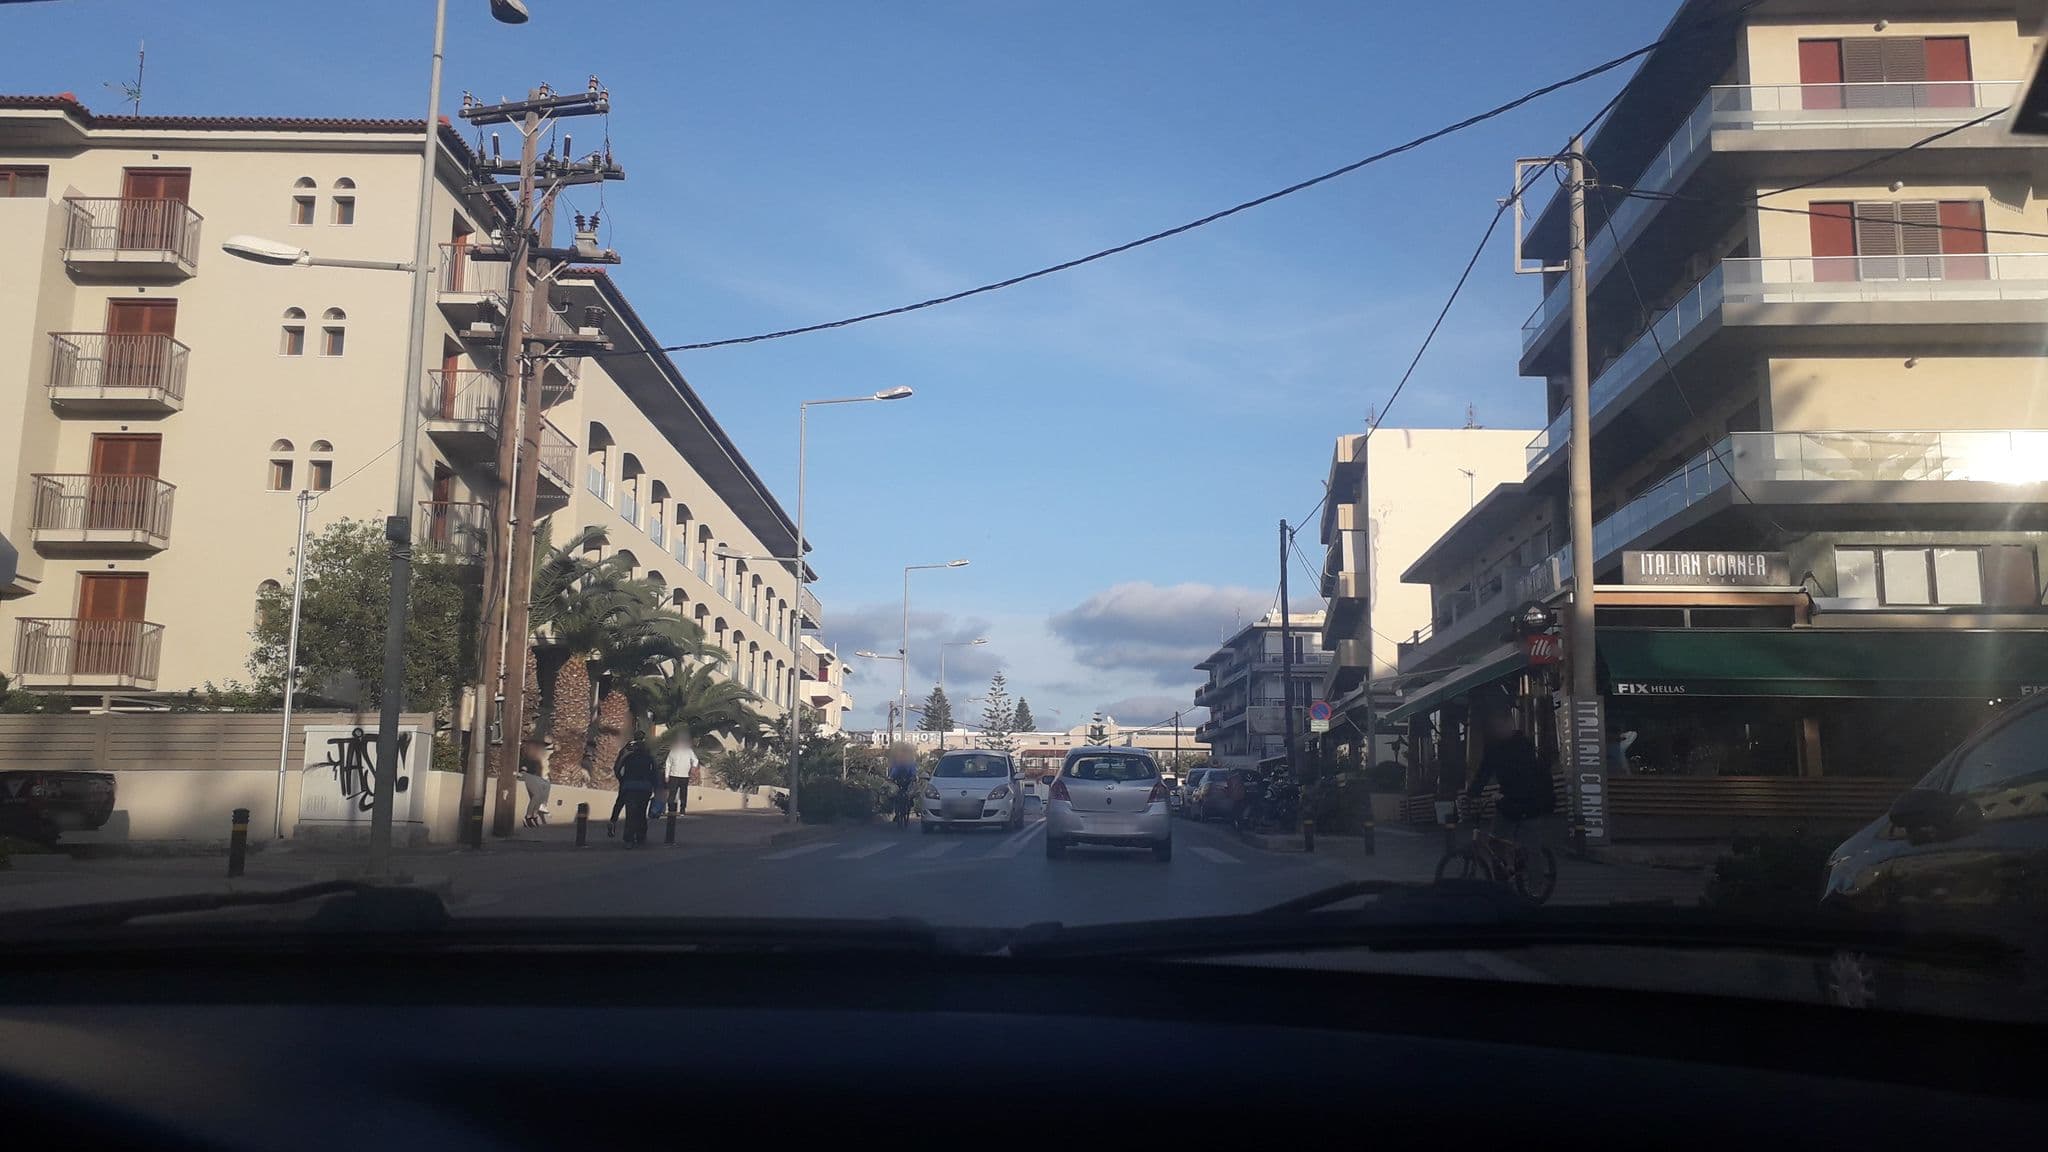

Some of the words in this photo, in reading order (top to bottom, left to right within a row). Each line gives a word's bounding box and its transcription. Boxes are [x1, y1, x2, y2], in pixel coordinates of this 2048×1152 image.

[1640, 553, 1701, 576] ITALIAN
[1707, 554, 1766, 577] CORNER
[1617, 683, 1649, 694] FIX
[1651, 685, 1686, 693] HELLAS
[1577, 701, 1600, 766] ITALIAN
